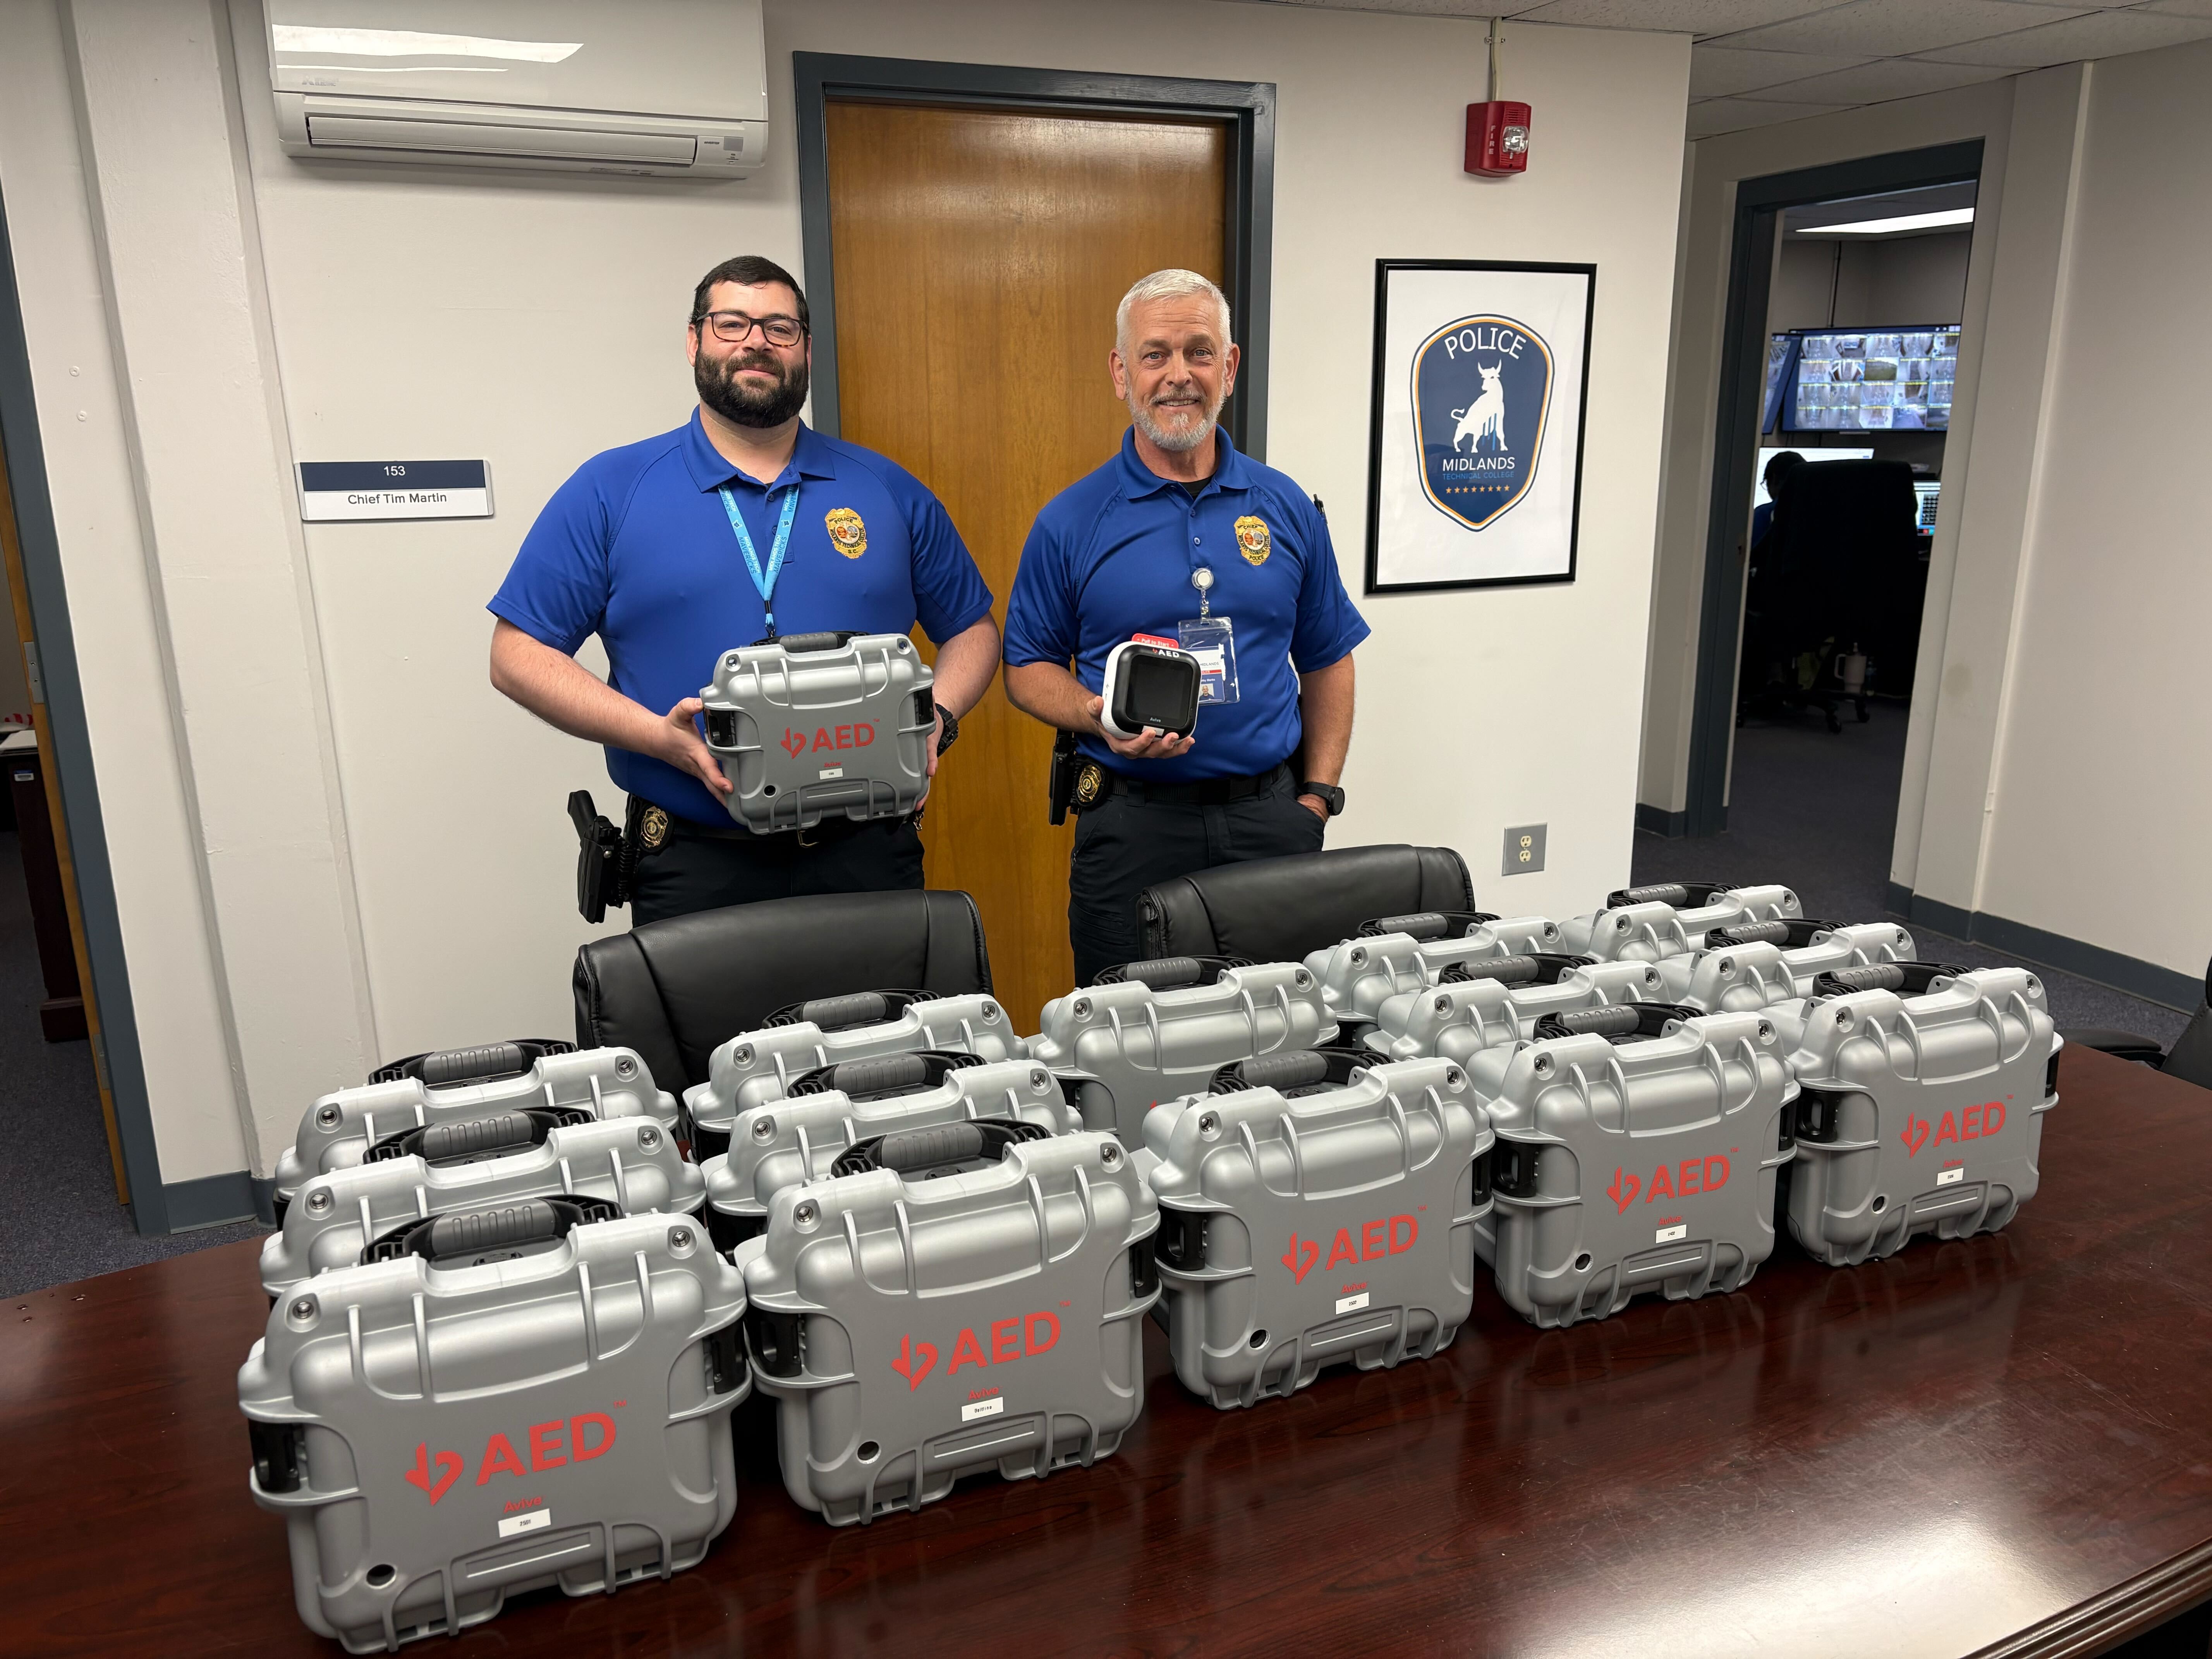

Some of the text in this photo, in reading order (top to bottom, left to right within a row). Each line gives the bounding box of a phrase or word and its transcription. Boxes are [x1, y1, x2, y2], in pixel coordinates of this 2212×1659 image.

[1444, 328, 1527, 359] POLICE
[384, 466, 405, 476] 153
[1443, 457, 1515, 471] MIDLANDS
[348, 493, 447, 504] Chief Tim Martin
[738, 537, 756, 574] MAVERICKS
[743, 536, 756, 560] MIDLANDS
[768, 547, 778, 571] MIDLANDS
[773, 536, 787, 574] MAVERICKS
[1158, 649, 1180, 658] AED
[812, 723, 875, 753] AED
[1933, 1101, 2006, 1147] AED
[1645, 1155, 1730, 1203] AED
[1326, 1214, 1418, 1270] AED
[947, 1311, 1061, 1375] AED
[968, 1388, 999, 1401] Avive
[476, 1412, 616, 1486] AED
[504, 1496, 542, 1513] Avive
